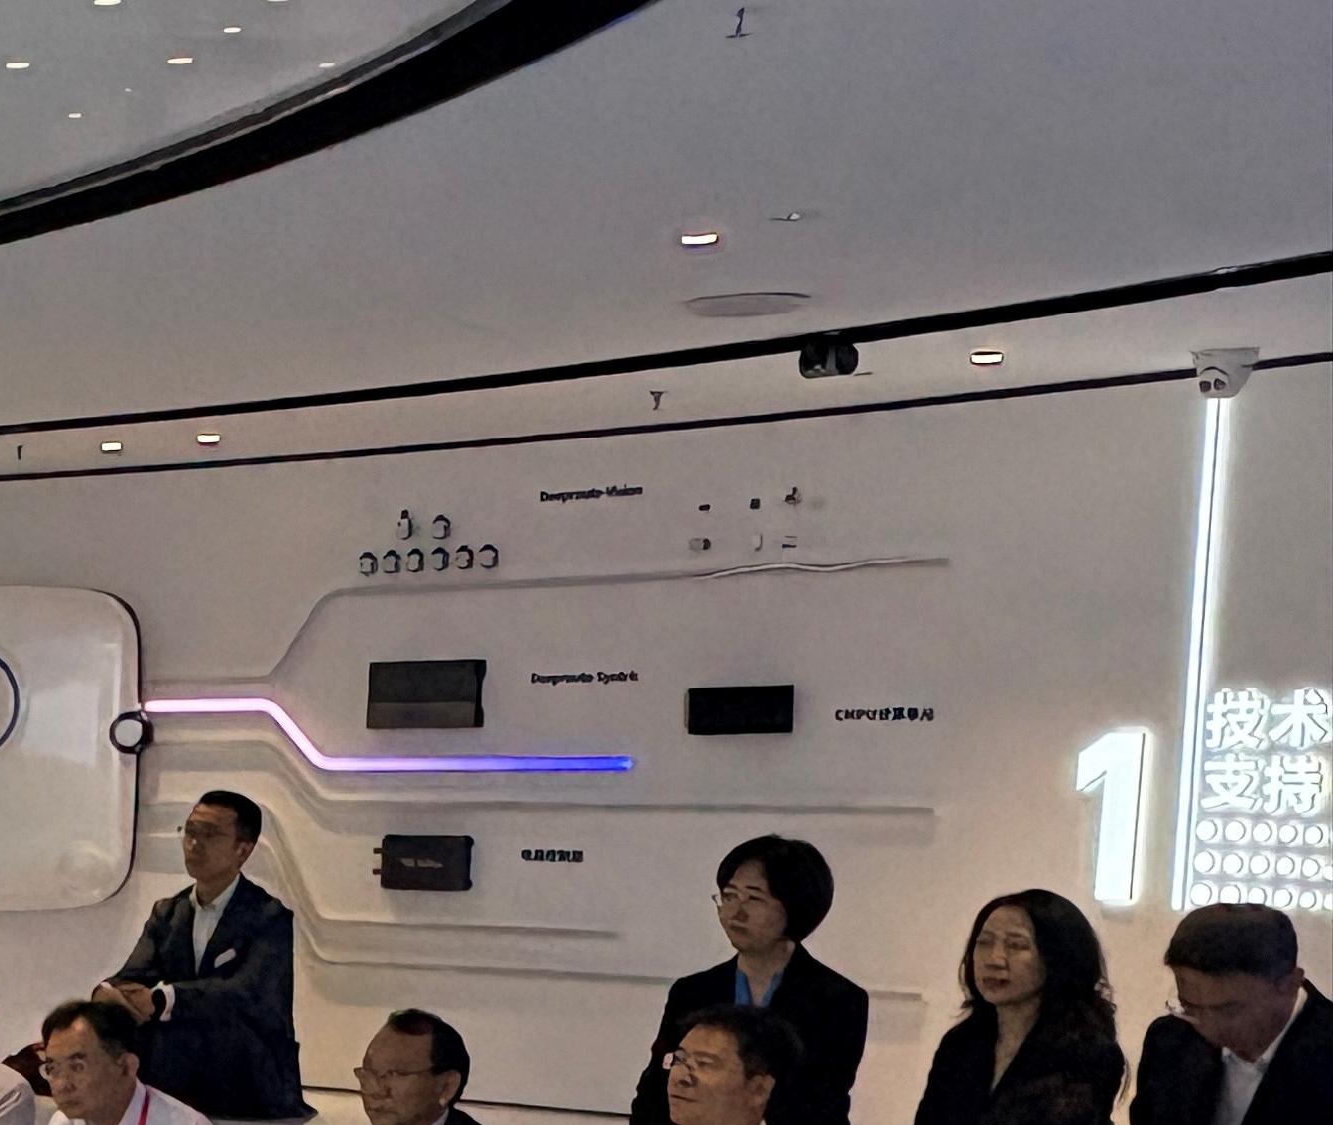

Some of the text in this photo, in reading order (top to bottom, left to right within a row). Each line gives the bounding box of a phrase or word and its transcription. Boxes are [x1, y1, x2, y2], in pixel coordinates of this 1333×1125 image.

[1206, 687, 1333, 750] 技术
[1200, 752, 1326, 816] 支持
[1075, 727, 1151, 906] 1
